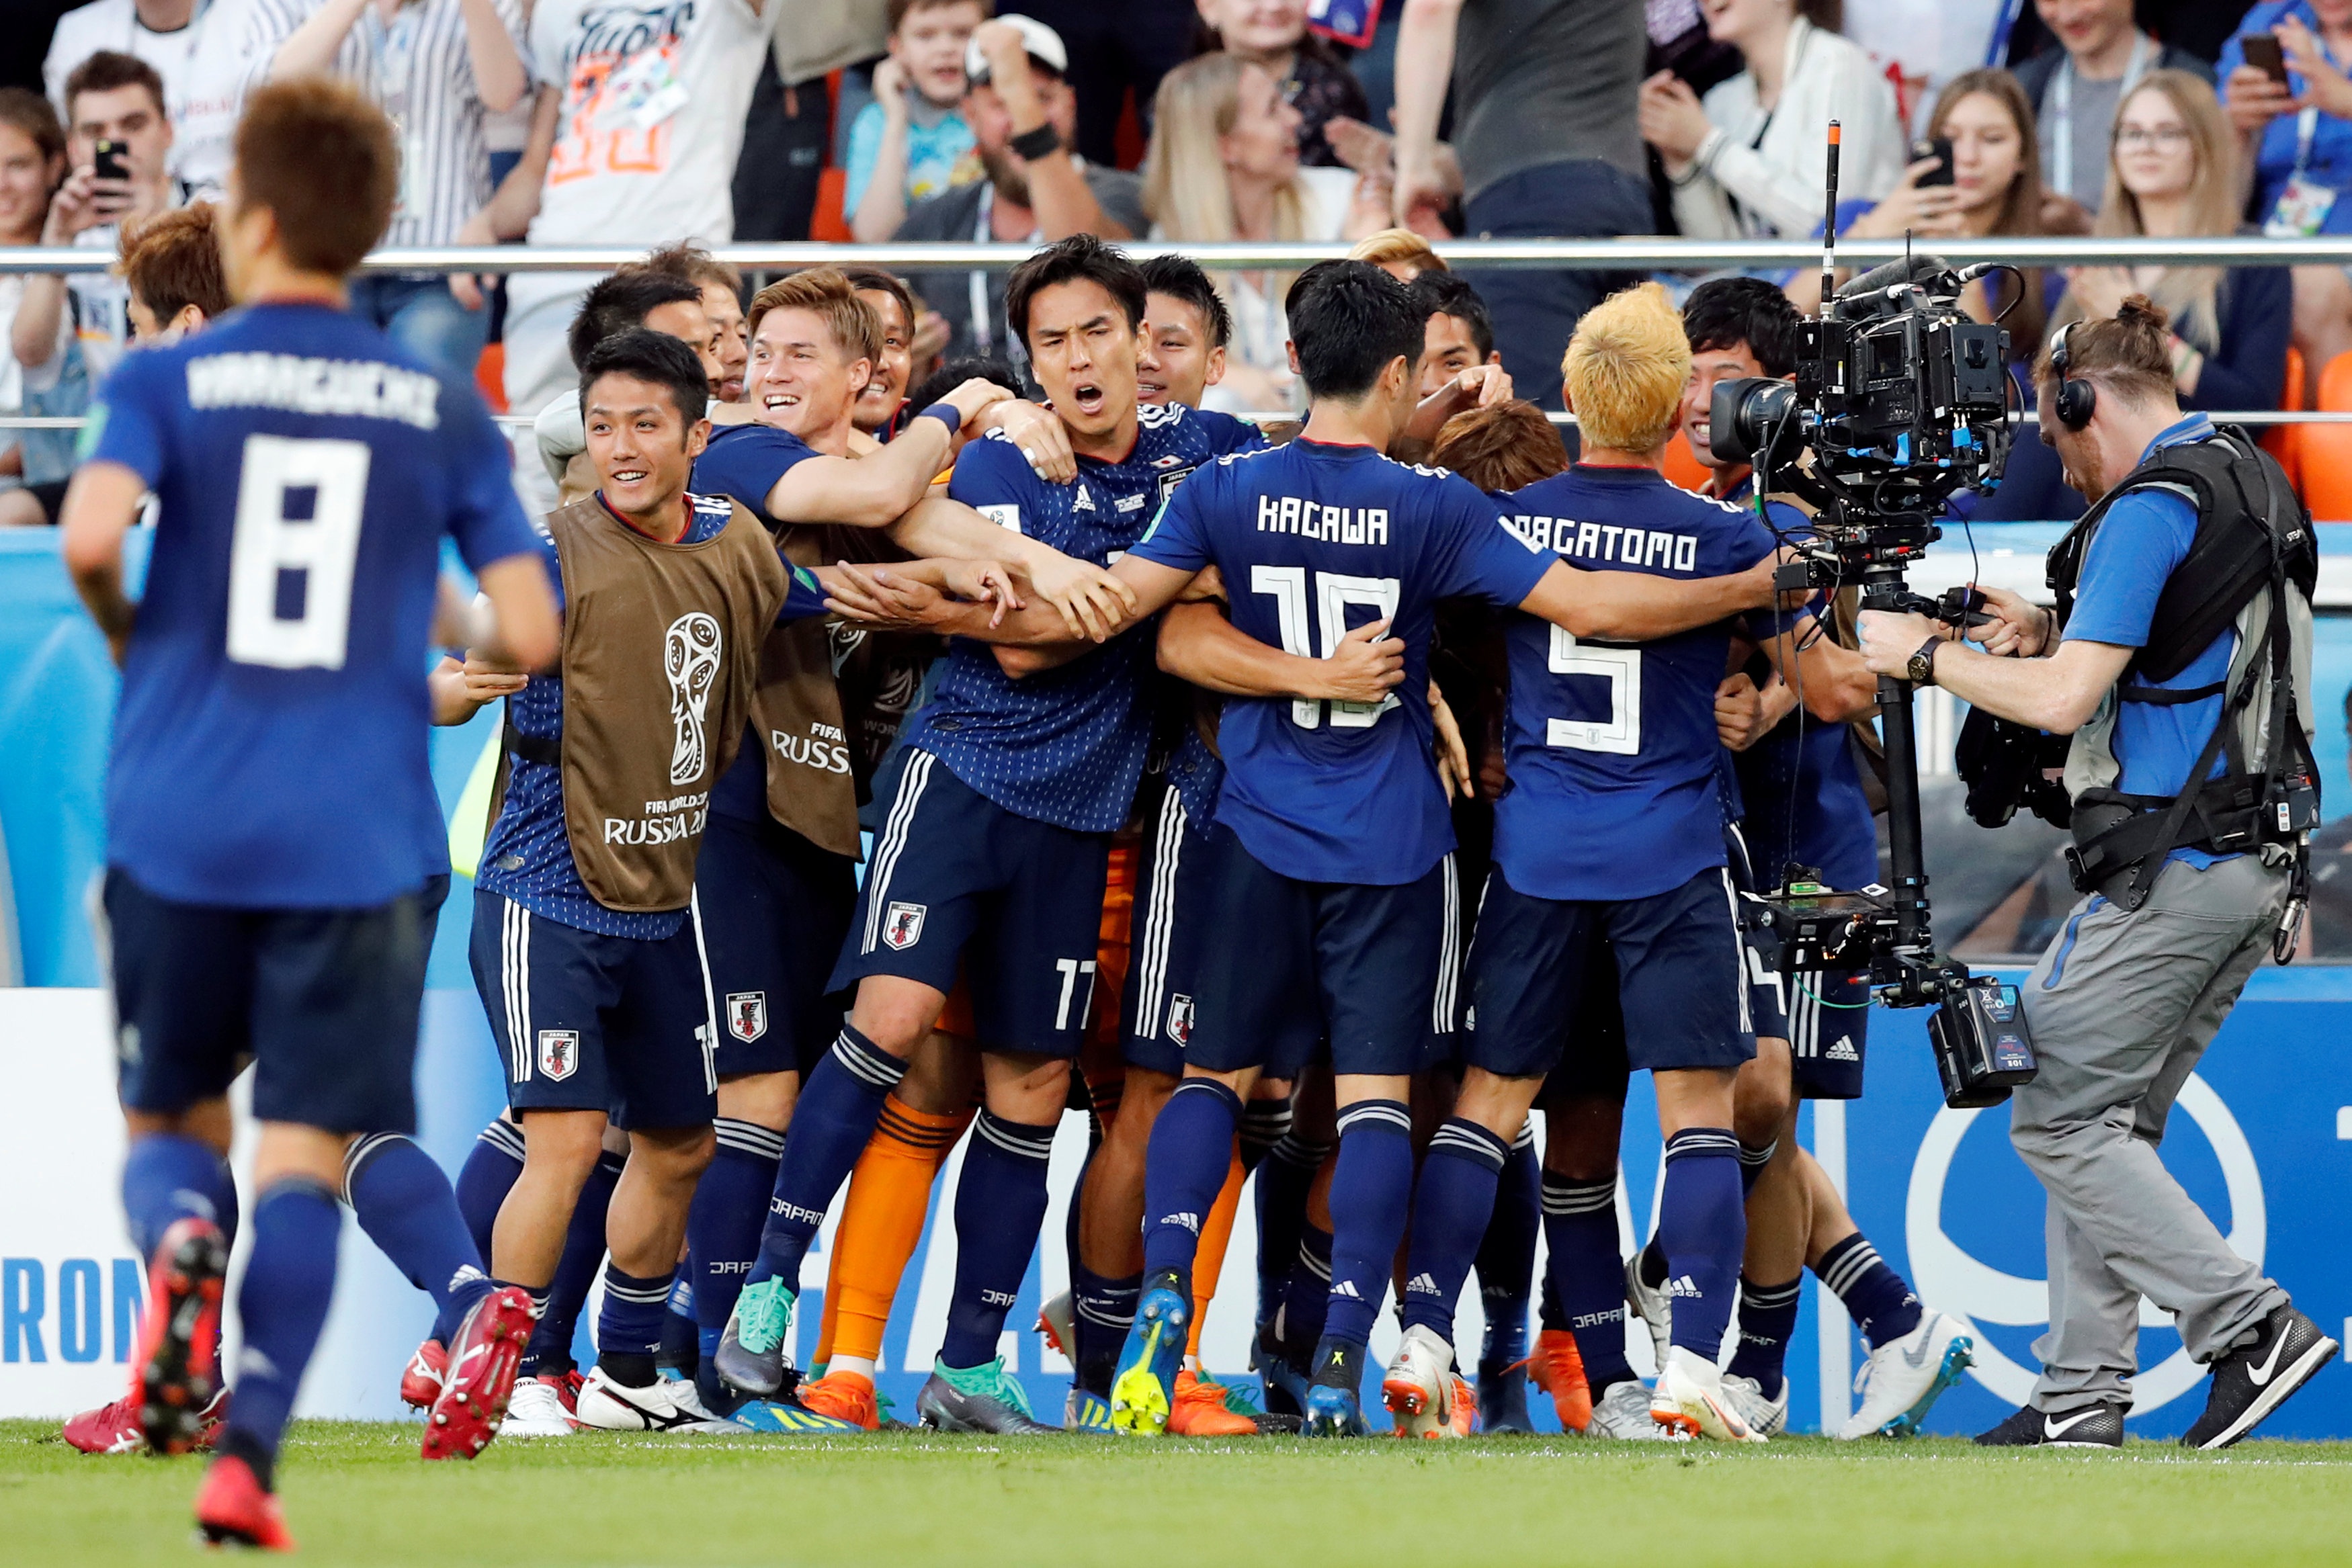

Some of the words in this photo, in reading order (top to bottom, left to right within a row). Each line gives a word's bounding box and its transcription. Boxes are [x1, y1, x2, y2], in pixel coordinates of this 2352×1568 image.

[1257, 494, 1388, 545] KAGAWA
[226, 433, 372, 671] 8
[1546, 622, 1641, 755] 5
[810, 722, 843, 741] FIFA
[772, 730, 853, 776] RUSS
[645, 799, 668, 814] FIFA
[605, 813, 688, 845] RUSSIA
[1825, 1051, 1859, 1061] adidas
[770, 1196, 824, 1226] JAPAN
[1406, 1284, 1441, 1297] adidas
